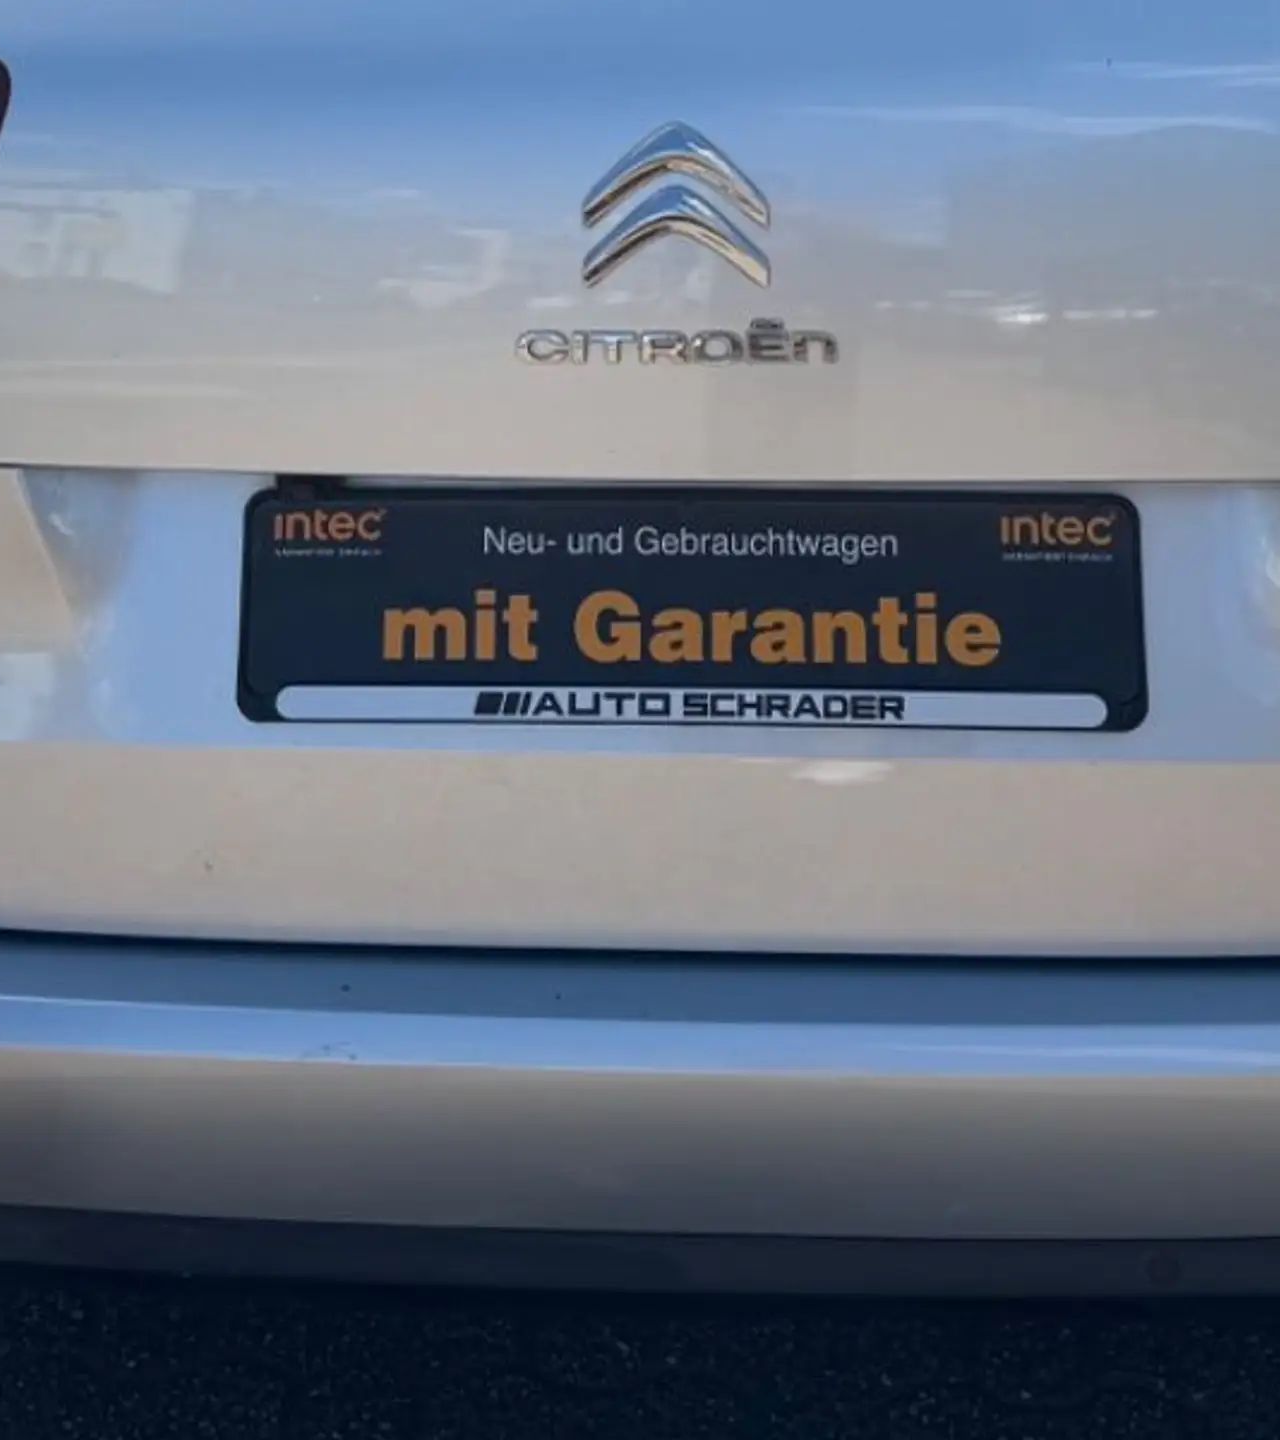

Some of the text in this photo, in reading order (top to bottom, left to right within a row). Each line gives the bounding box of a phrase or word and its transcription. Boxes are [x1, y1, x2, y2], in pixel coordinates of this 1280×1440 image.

[273, 508, 386, 542] intec
[999, 511, 1114, 546] intec
[482, 526, 900, 564] Neu- und Gebrauchtwagen
[381, 588, 1003, 667] mit Garantie
[532, 691, 907, 721] AUTO SCHRADER
